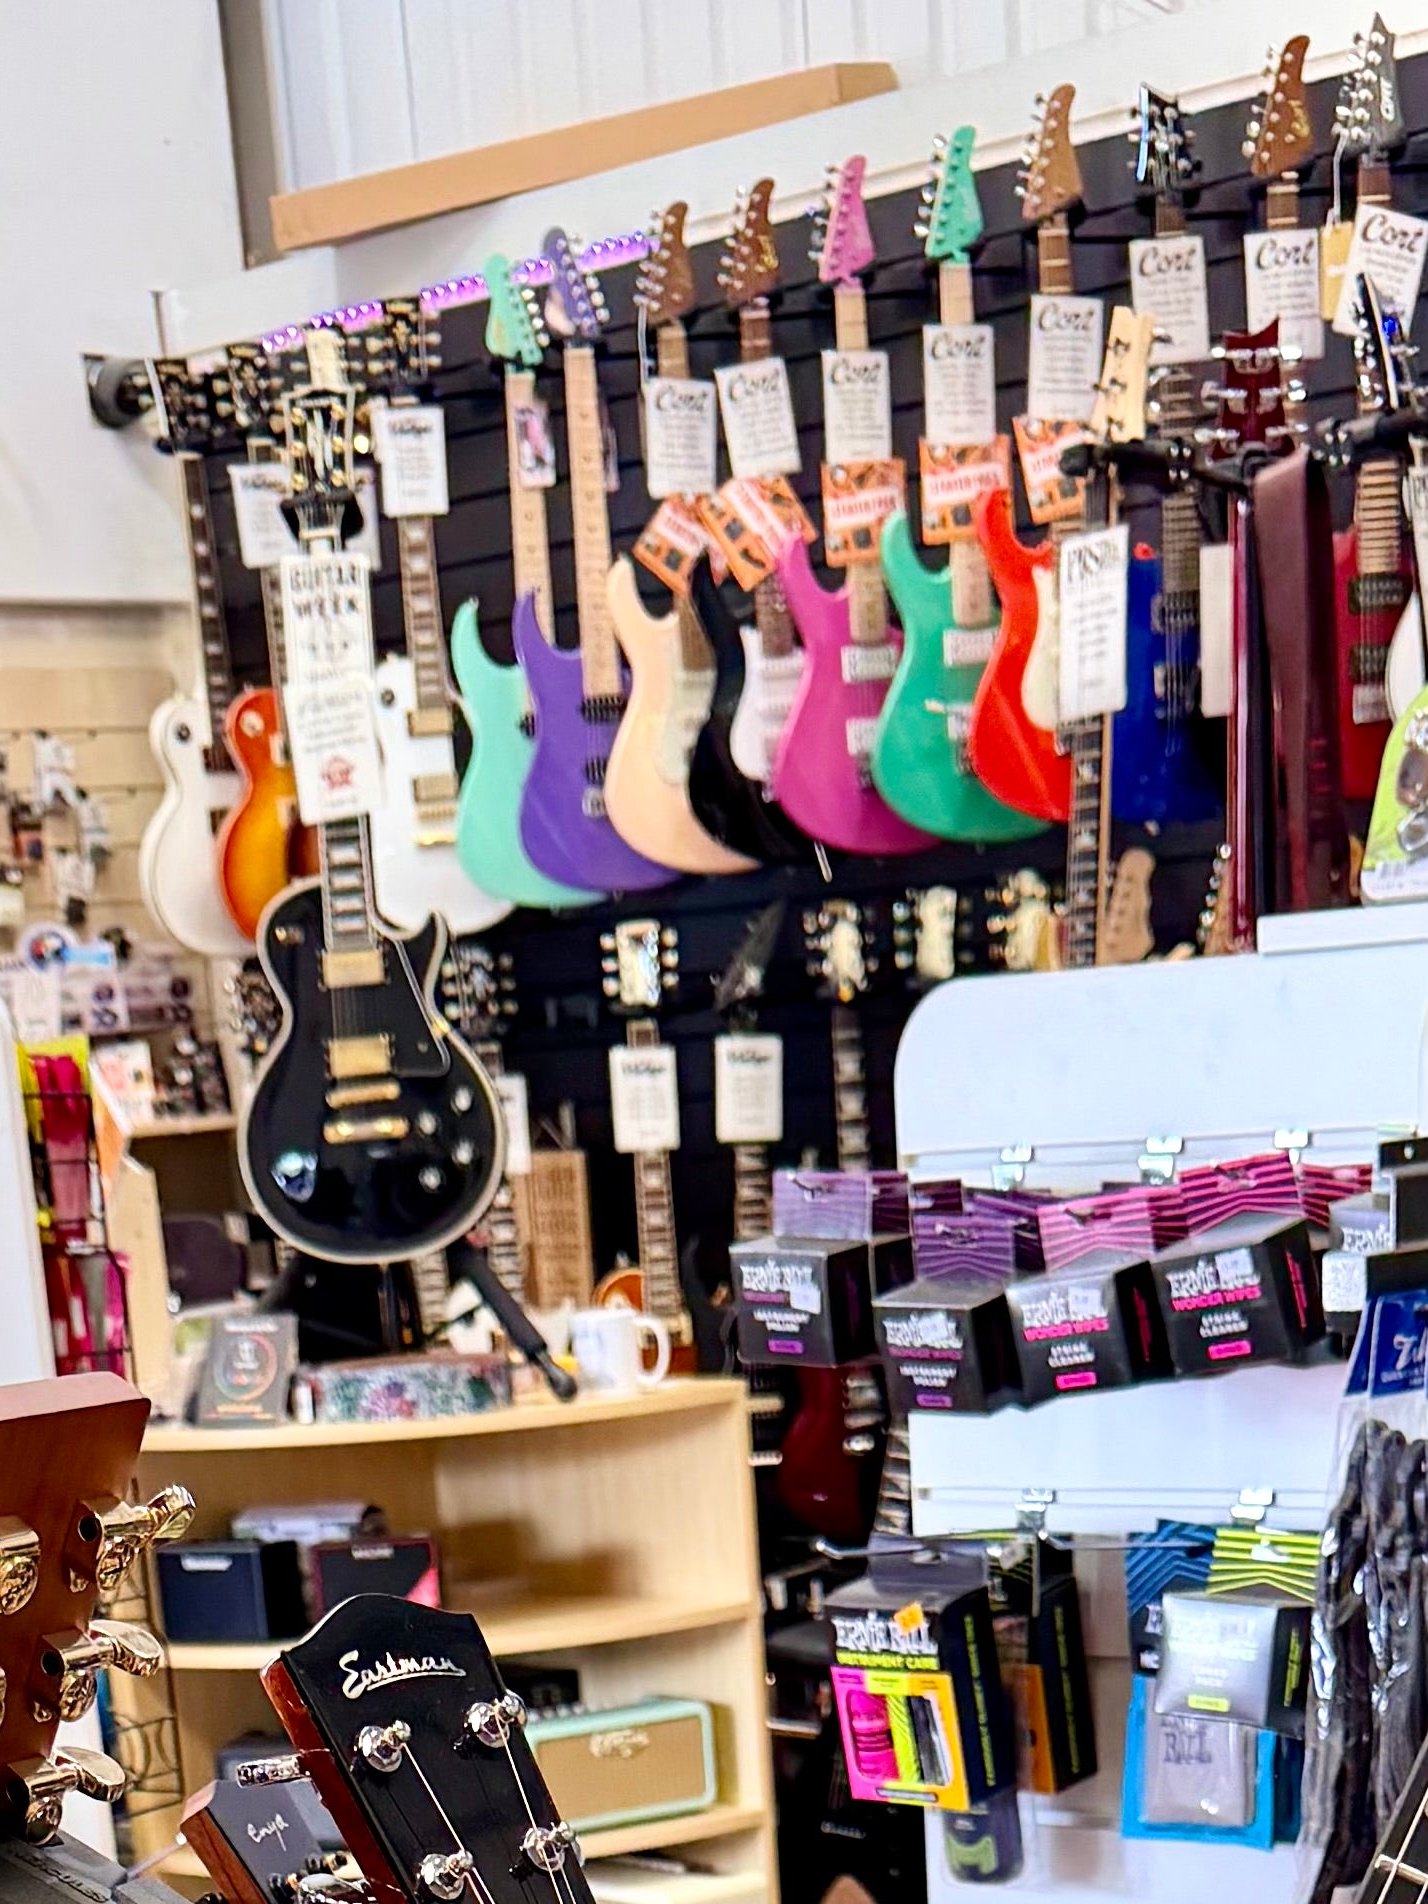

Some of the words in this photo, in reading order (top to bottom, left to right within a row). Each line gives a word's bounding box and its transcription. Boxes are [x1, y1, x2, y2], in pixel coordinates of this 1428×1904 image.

[1361, 212, 1423, 253] Cort
[1140, 244, 1197, 279] Cort
[1256, 235, 1315, 271] Cort
[1341, 1222, 1392, 1252] ERNI
[1172, 1295, 1222, 1313] WONDER
[1223, 1285, 1262, 1302] WIPES
[1023, 1323, 1072, 1342] WONDER
[1072, 1318, 1109, 1334] WIPES
[831, 1609, 888, 1653] ERNIE
[338, 1649, 467, 1700] Eastman
